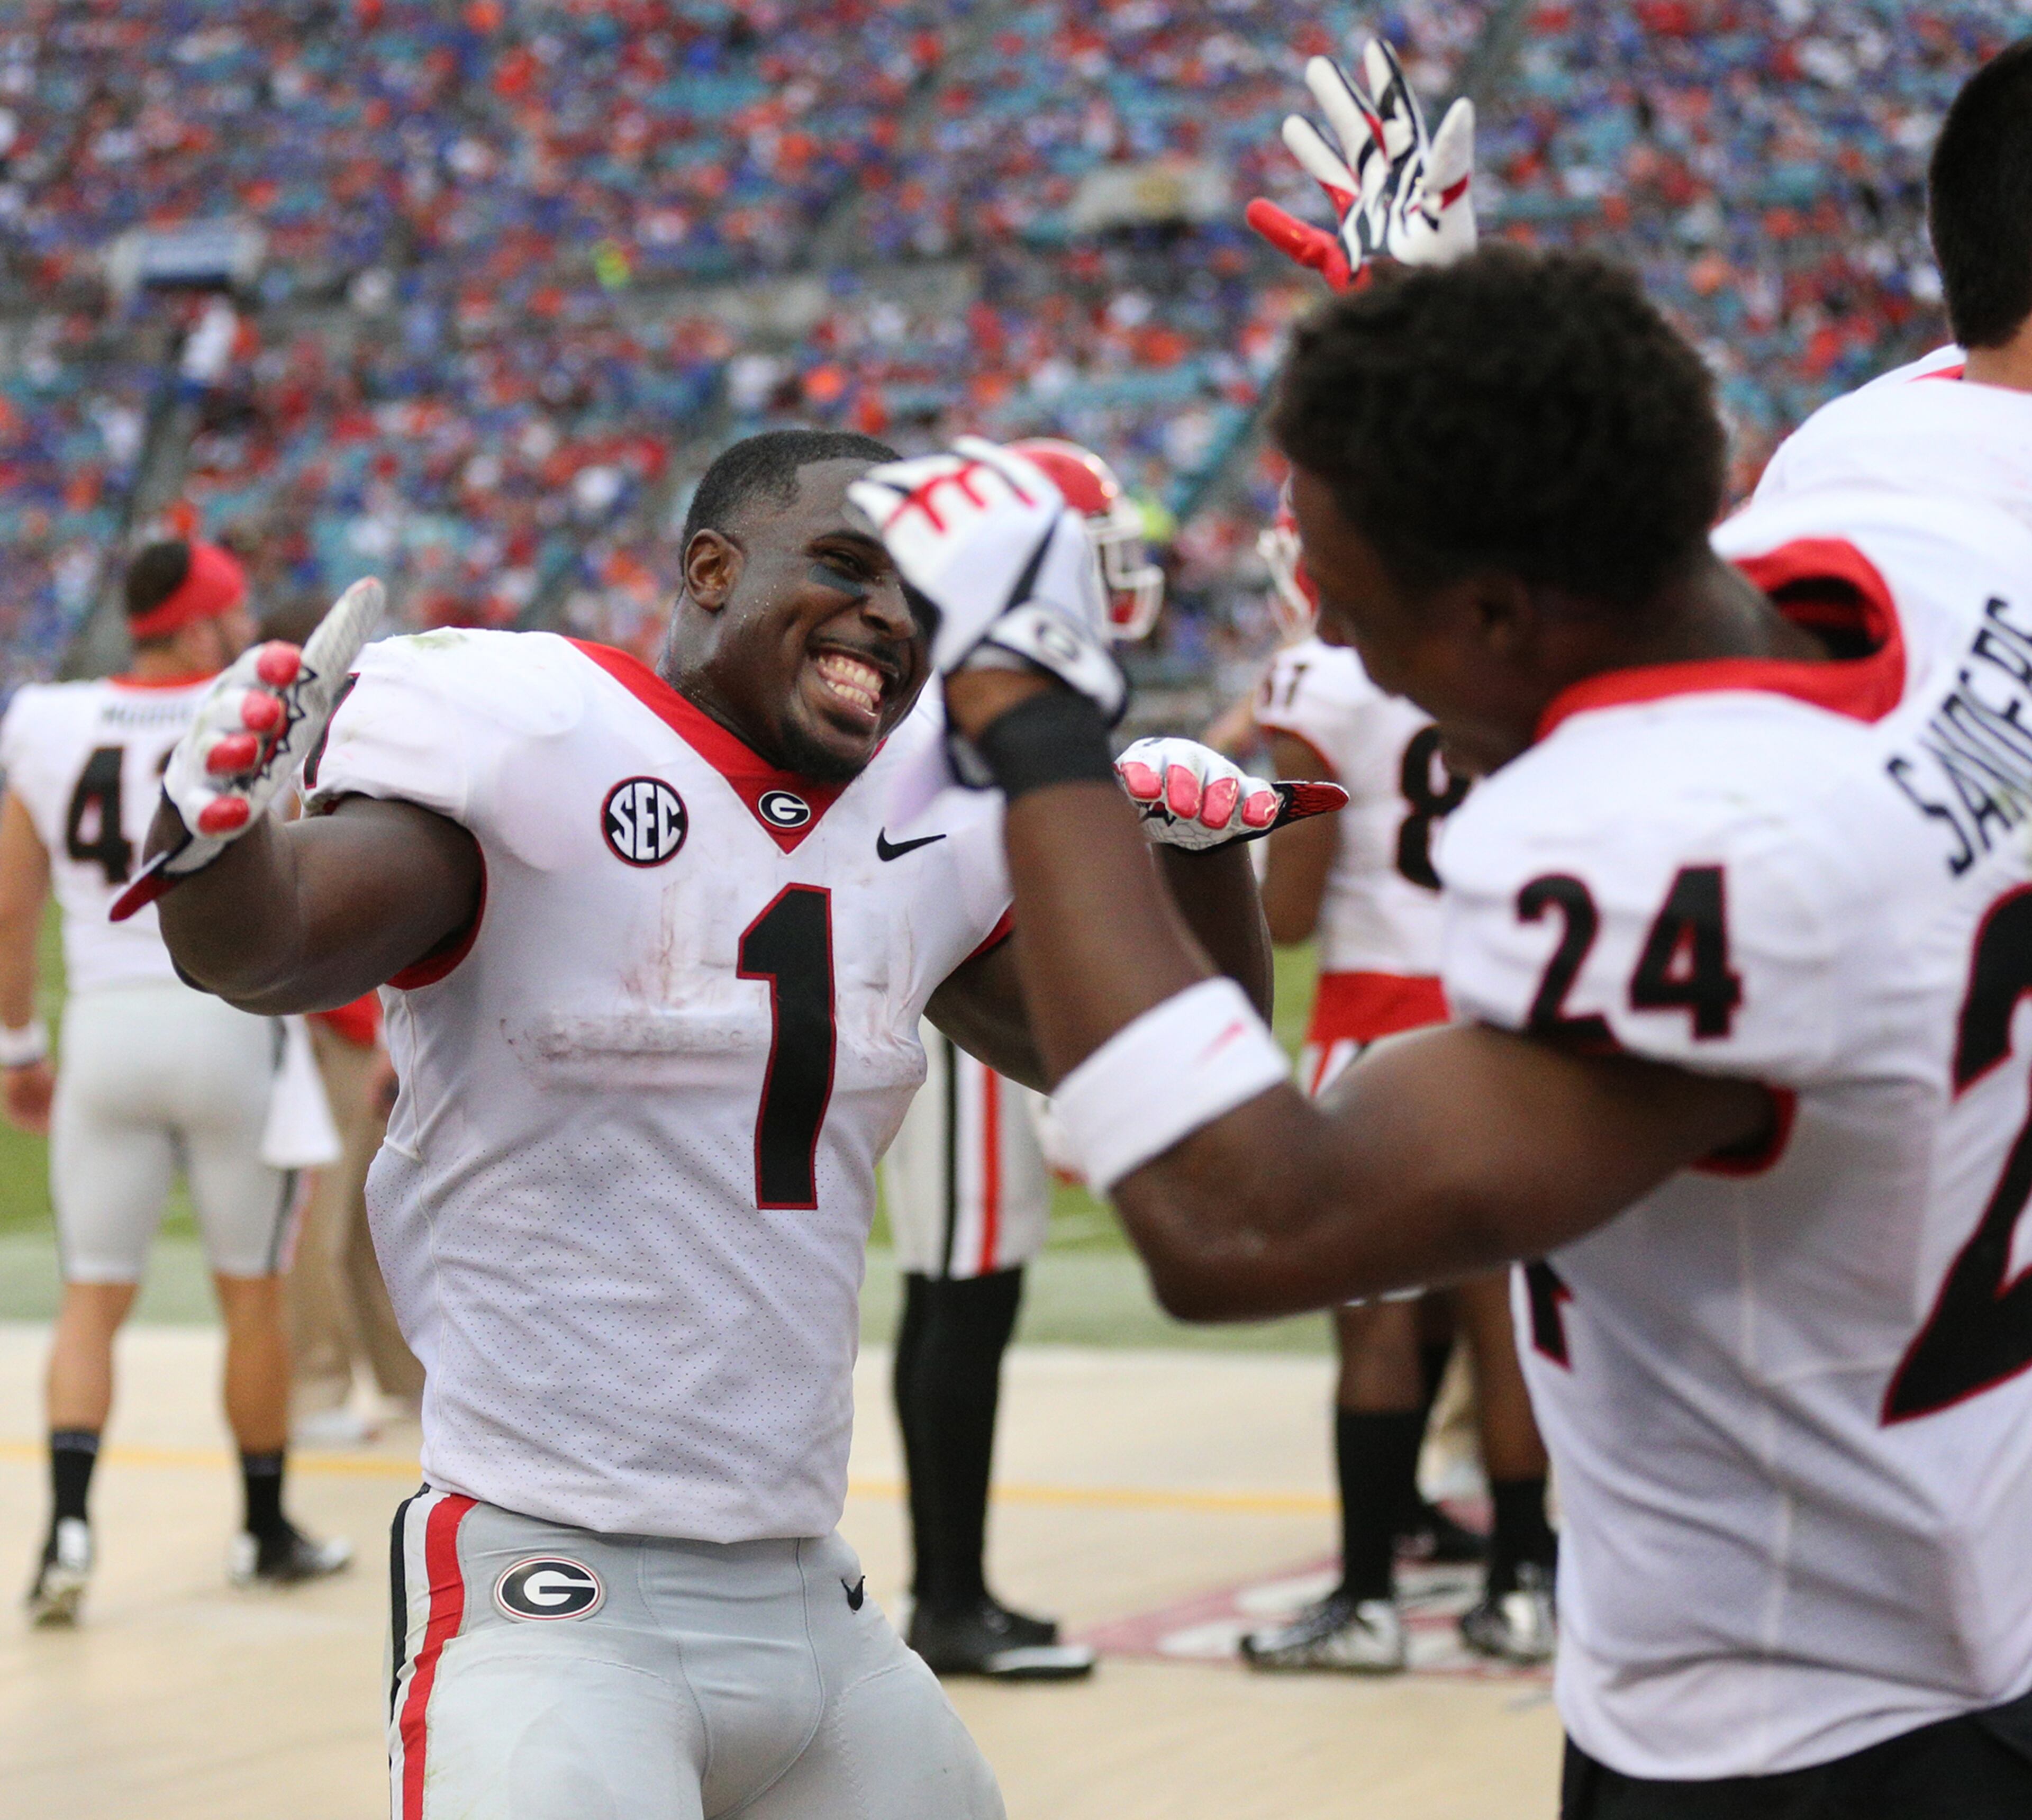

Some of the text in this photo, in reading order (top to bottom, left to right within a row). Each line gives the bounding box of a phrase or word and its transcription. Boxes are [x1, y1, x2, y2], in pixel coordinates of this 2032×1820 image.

[65, 744, 175, 885] 4
[608, 781, 682, 861] SEC
[759, 791, 810, 826] G
[1515, 865, 1744, 1053] 24
[736, 882, 836, 1210] 1
[501, 1561, 597, 1616] G
